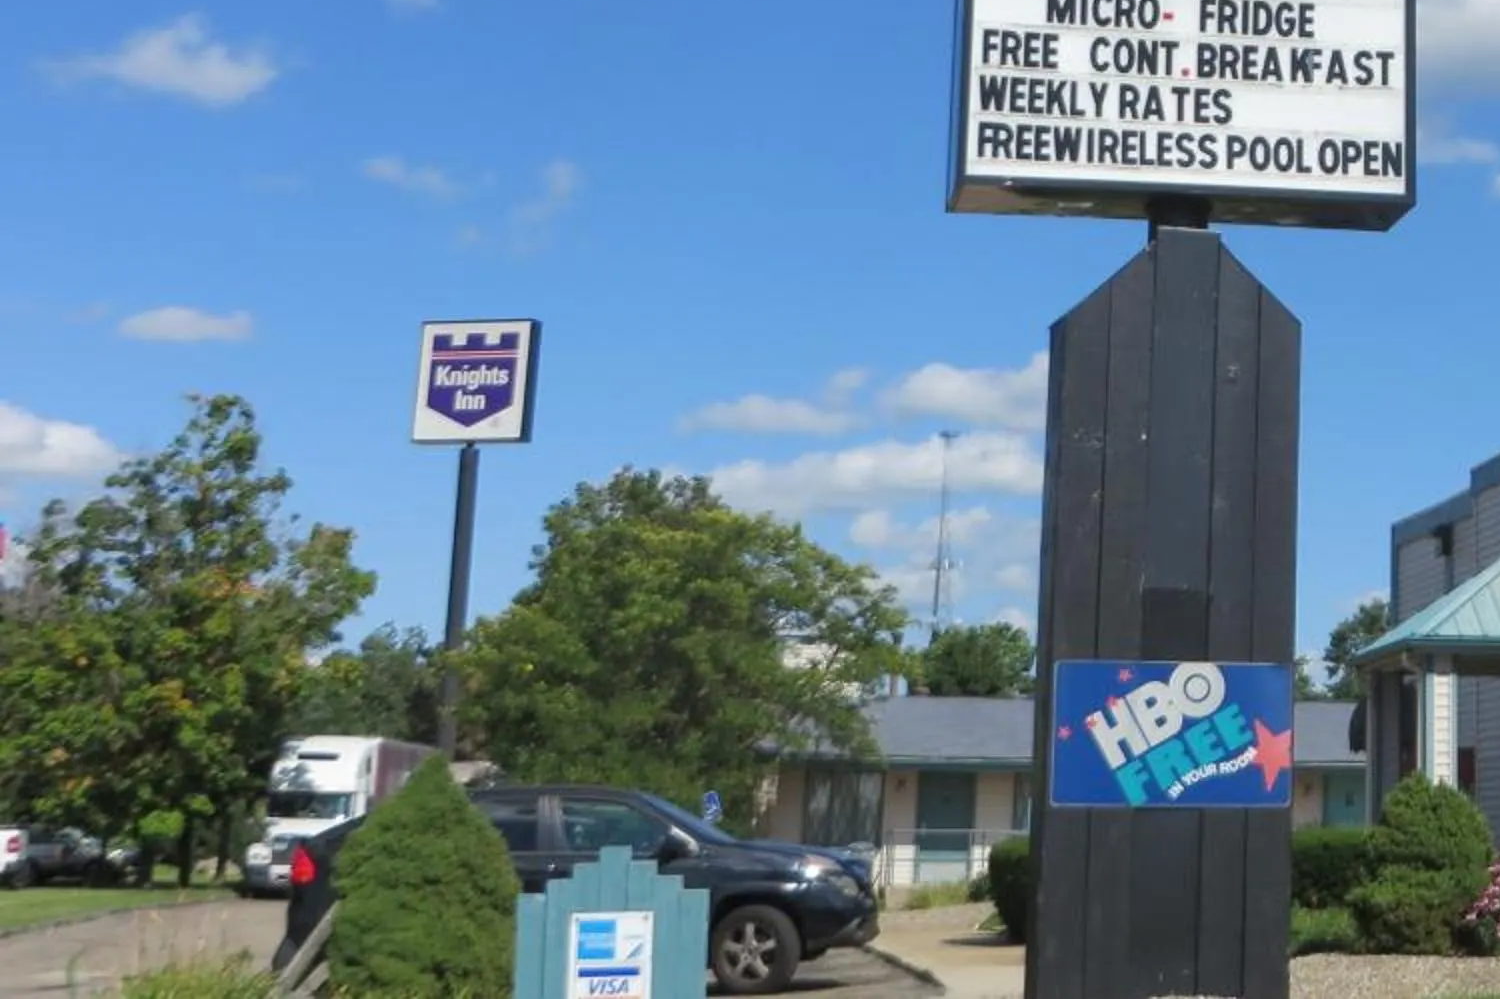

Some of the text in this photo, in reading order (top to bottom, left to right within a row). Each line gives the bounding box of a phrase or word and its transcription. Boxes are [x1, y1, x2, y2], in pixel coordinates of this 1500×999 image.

[982, 29, 1059, 70] FREE
[1197, 42, 1395, 87] BREAKFAST
[979, 74, 1233, 126] WEEKLY RATES
[1226, 136, 1312, 174] POOL
[1318, 139, 1402, 178] OPEN
[435, 364, 510, 390] Knights
[454, 390, 486, 410] Inn
[1086, 661, 1225, 770] HBO
[1115, 703, 1254, 808] FREE
[1168, 780, 1184, 800] IN
[1181, 763, 1217, 786] YOUR
[588, 978, 630, 995] VISA
